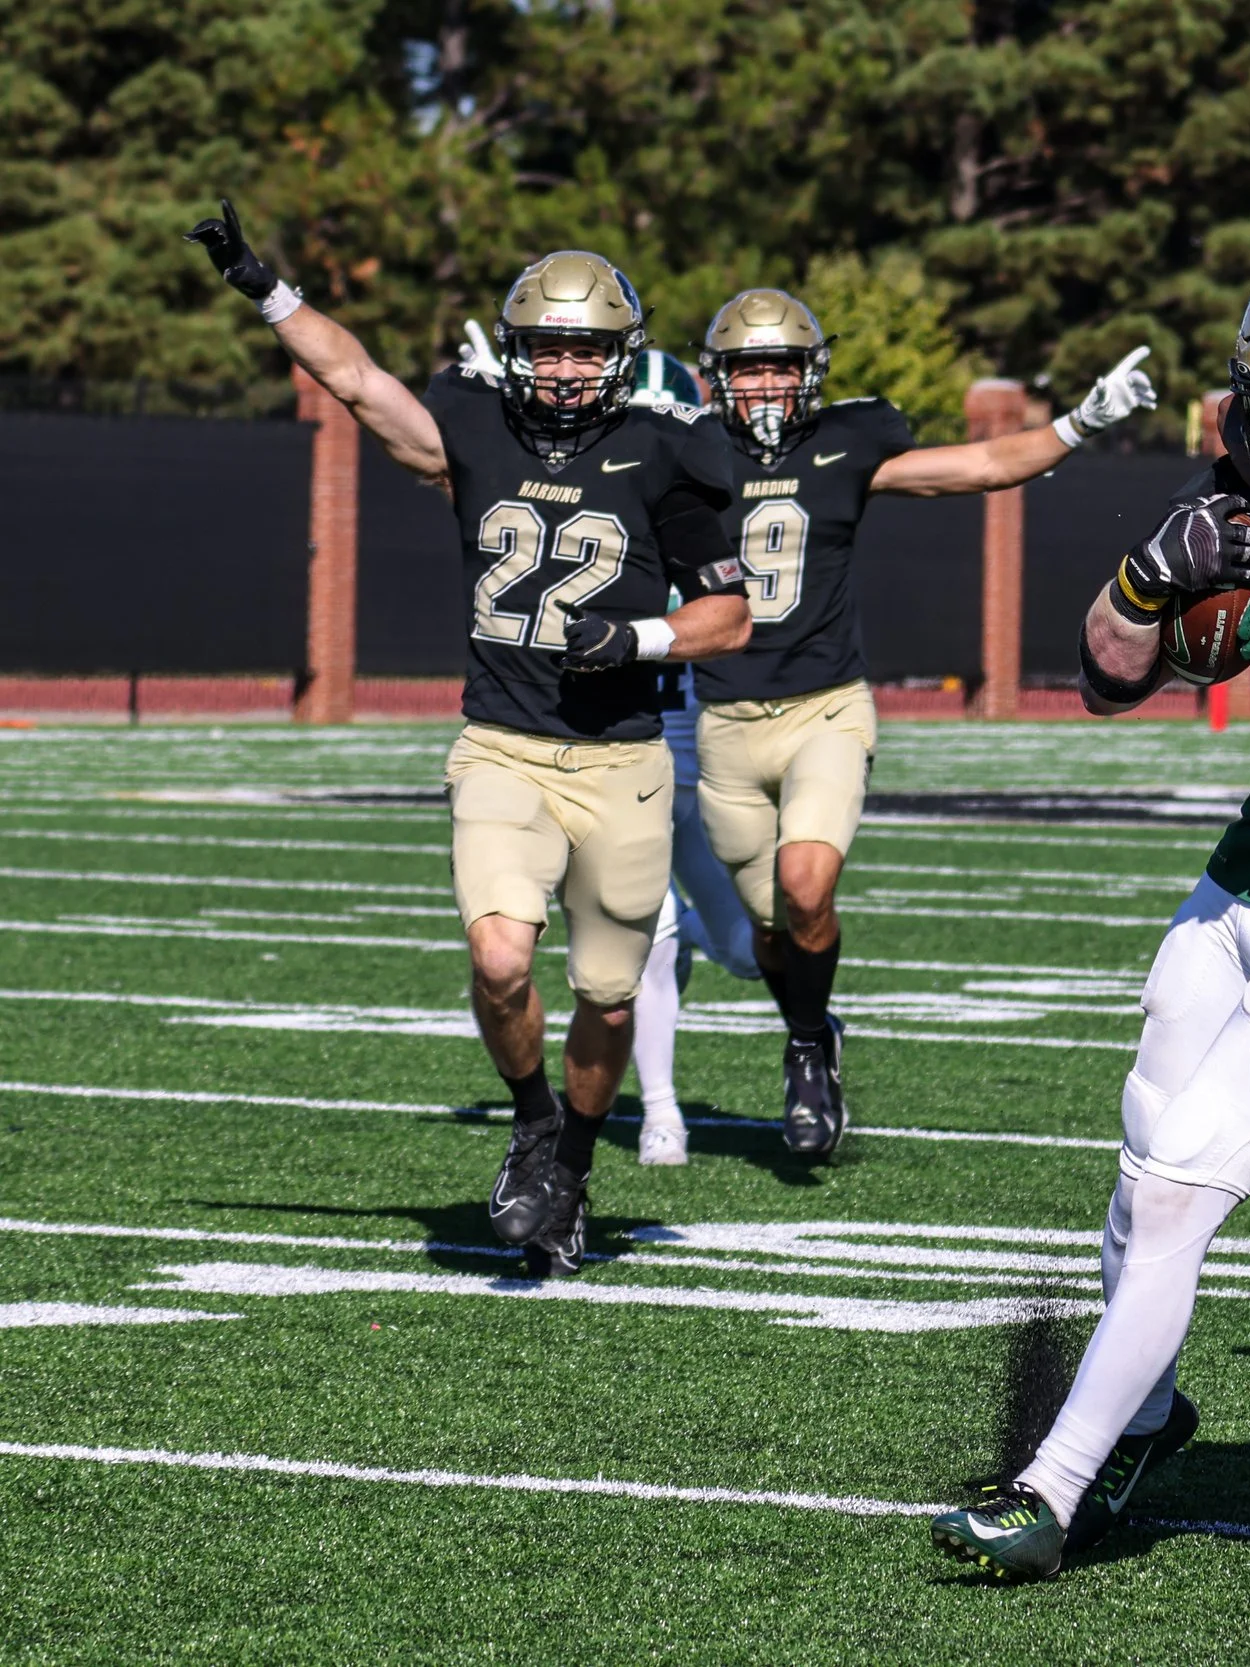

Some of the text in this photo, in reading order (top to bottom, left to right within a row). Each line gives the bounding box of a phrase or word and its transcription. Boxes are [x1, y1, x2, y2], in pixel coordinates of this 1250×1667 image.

[518, 480, 583, 504] HARDING
[743, 479, 799, 498] HARDING
[470, 500, 629, 651] 22
[740, 499, 810, 623] 9
